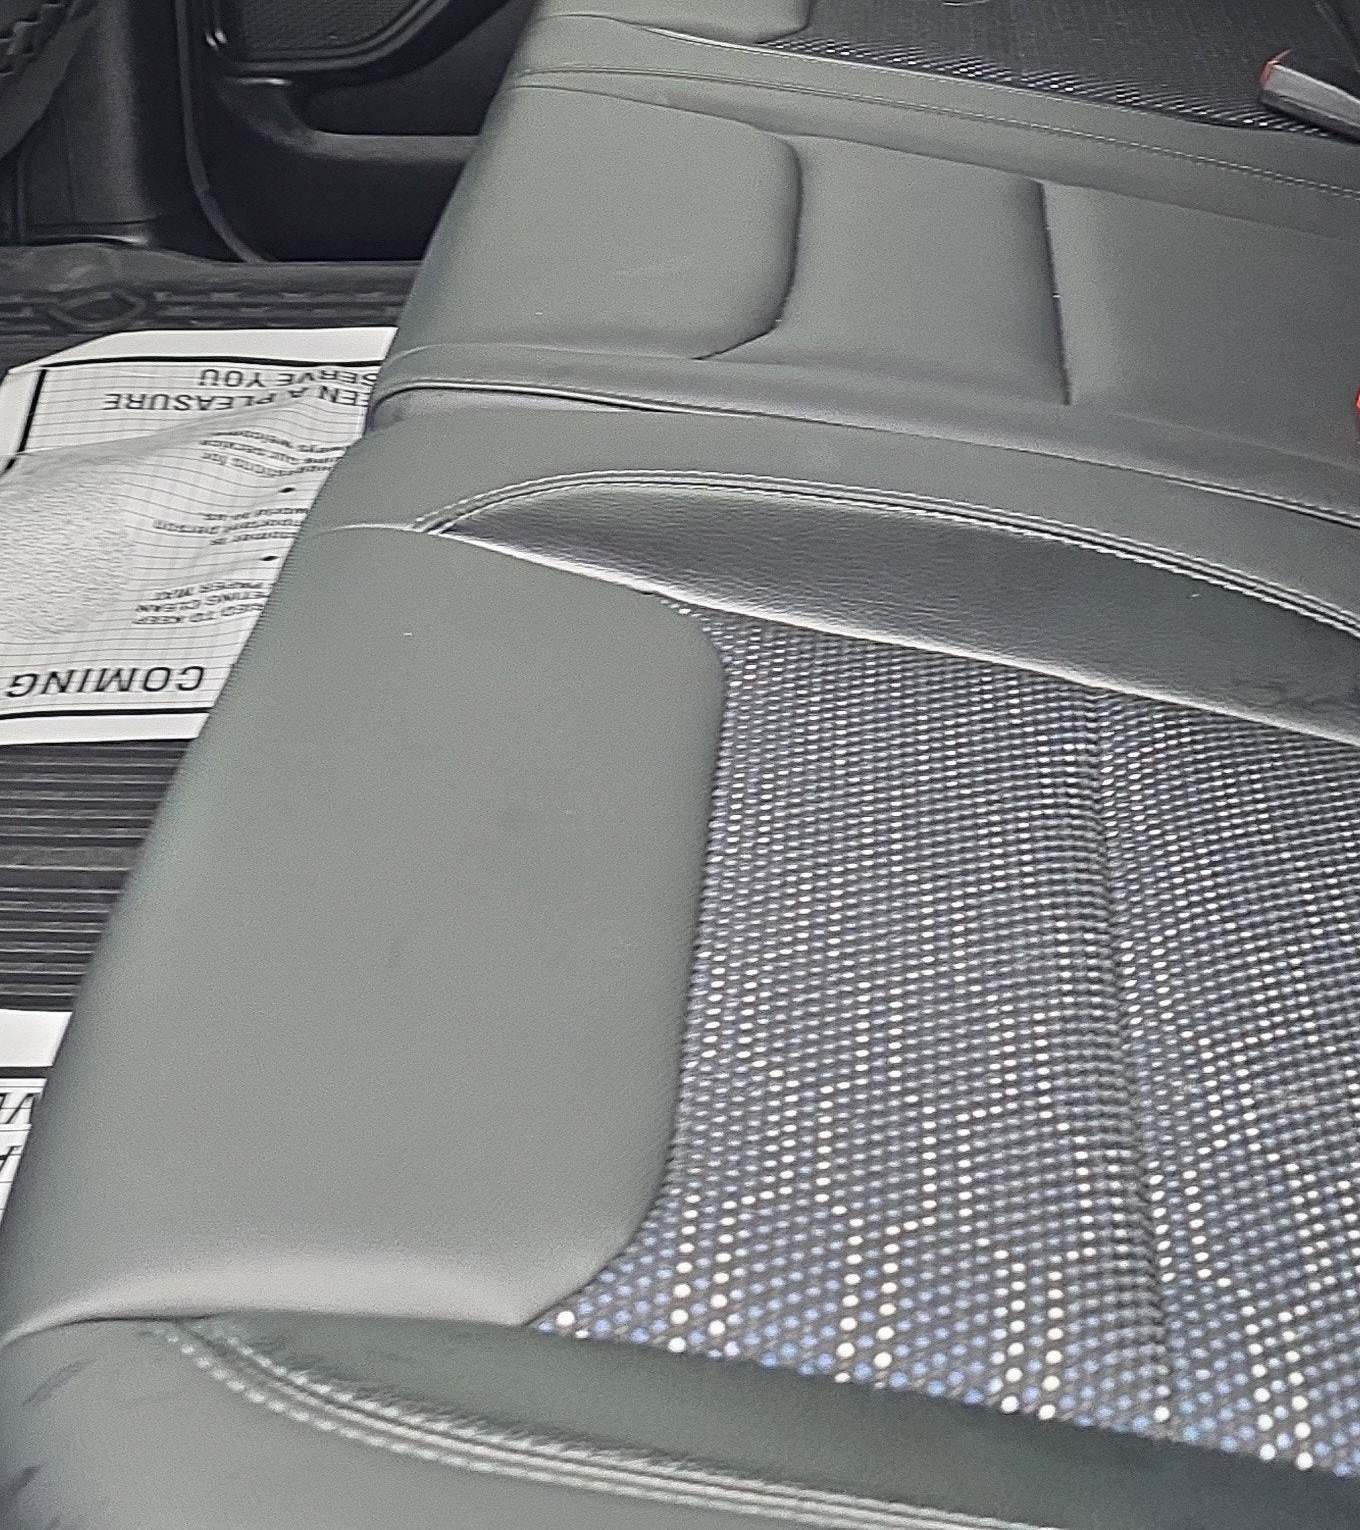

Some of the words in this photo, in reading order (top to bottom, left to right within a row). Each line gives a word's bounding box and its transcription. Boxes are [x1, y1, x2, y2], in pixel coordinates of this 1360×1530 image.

[196, 368, 268, 388] YOU
[101, 392, 277, 412] PLEASURE
[287, 387, 309, 399] A
[4, 666, 205, 698] COMING
